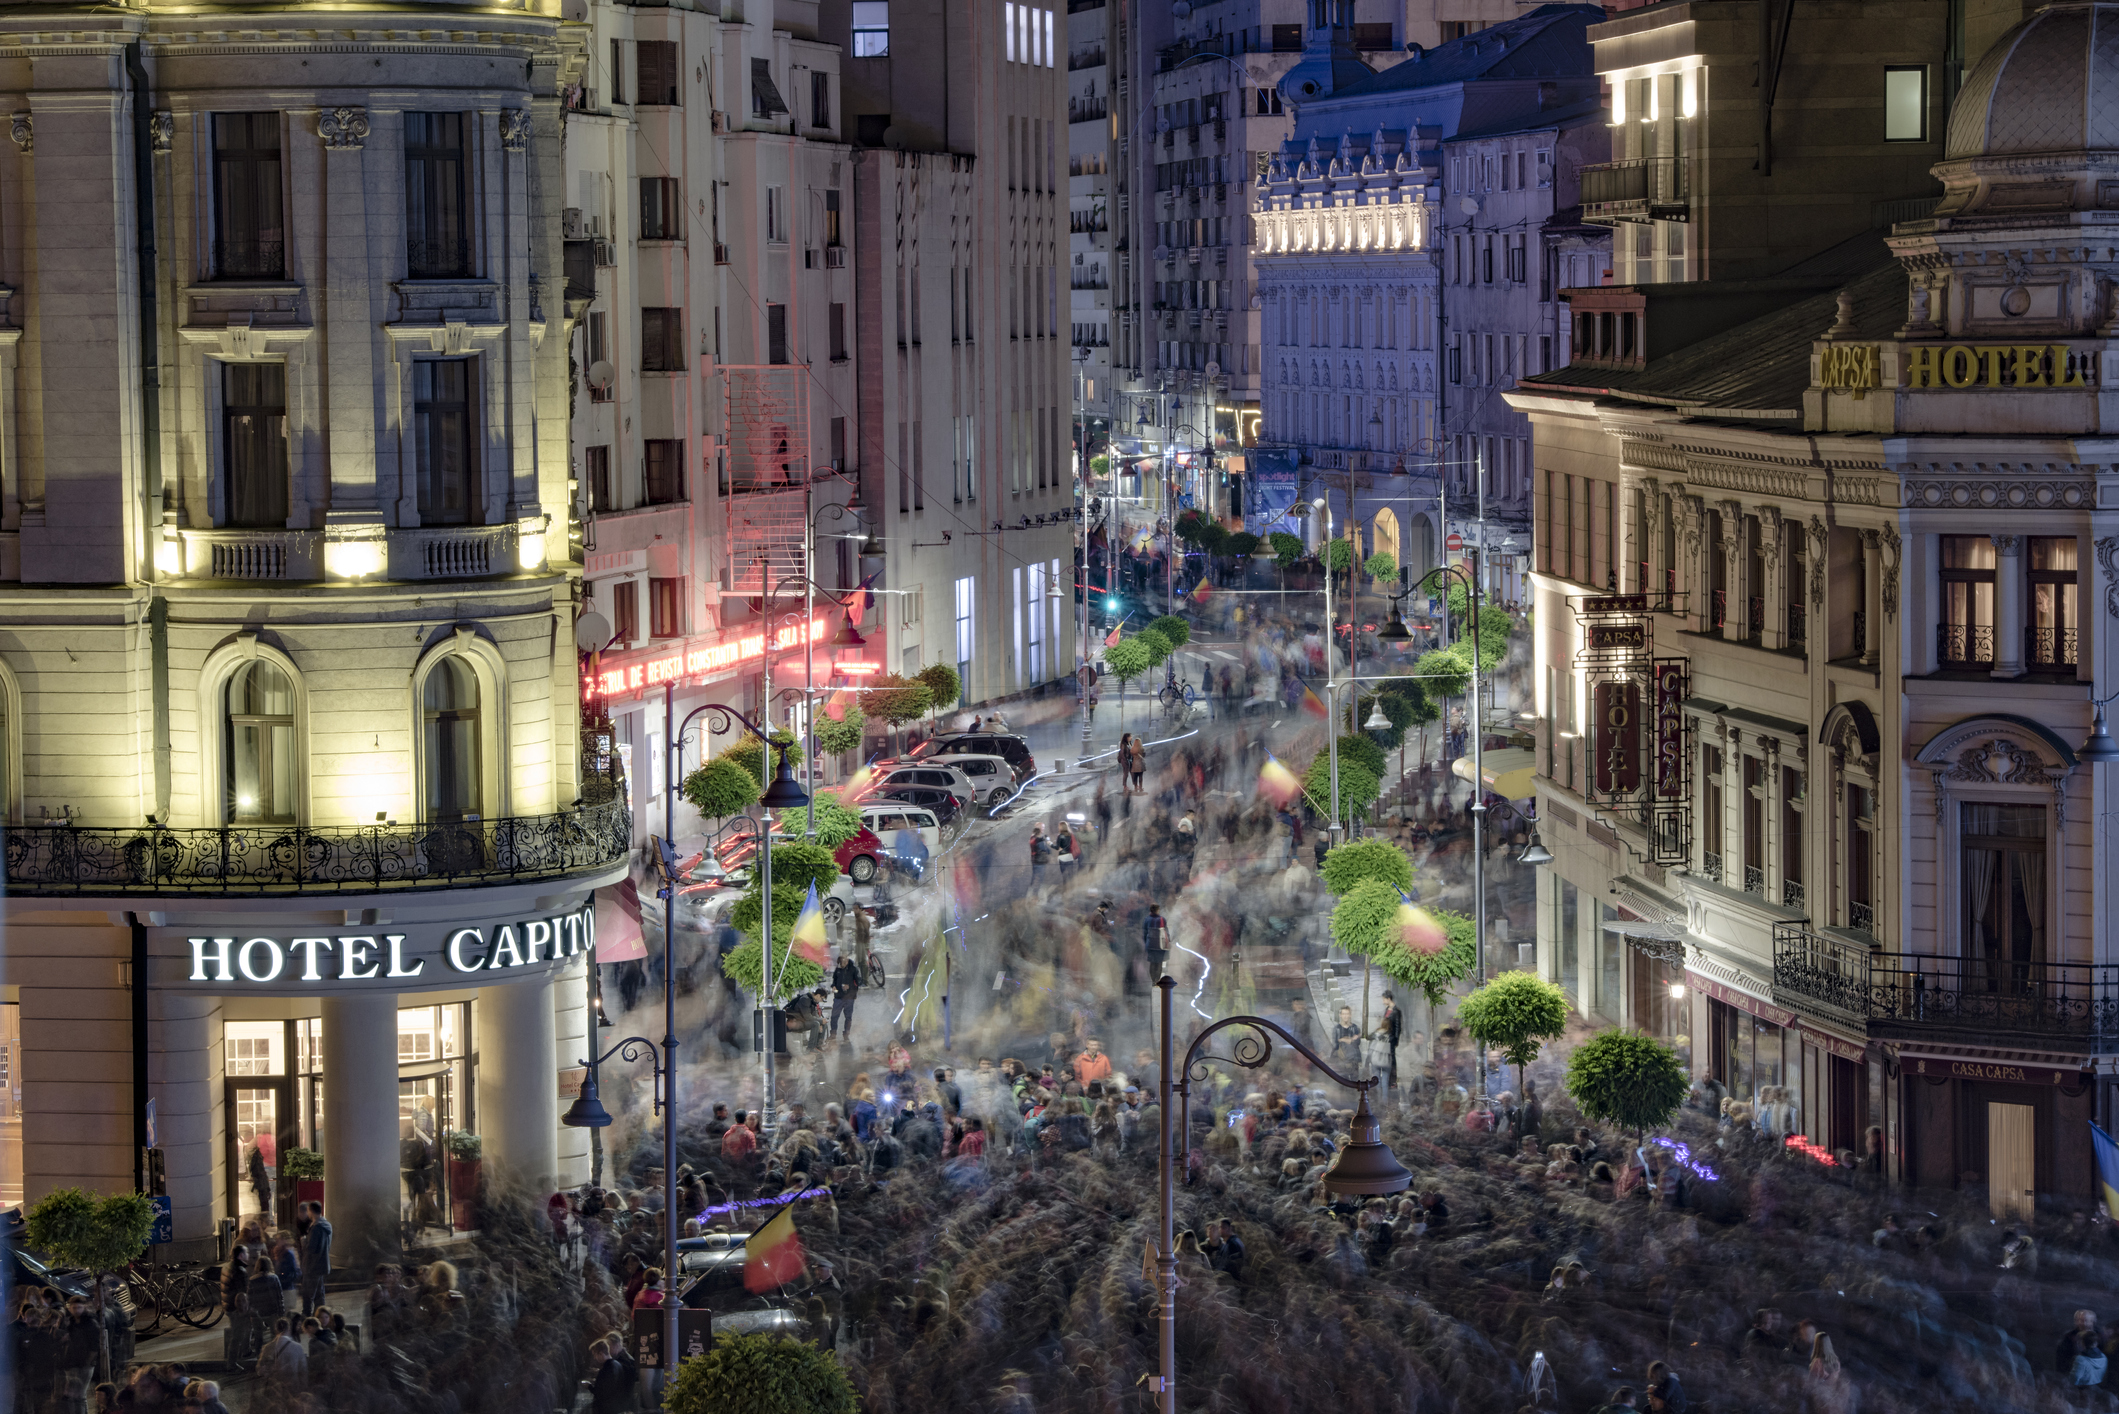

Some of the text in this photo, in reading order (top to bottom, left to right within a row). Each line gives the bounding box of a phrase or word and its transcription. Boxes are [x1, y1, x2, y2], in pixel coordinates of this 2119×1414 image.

[1909, 345, 2087, 388] HOTEL
[630, 664, 644, 689] DE
[687, 641, 739, 674] CONSTANTIN
[778, 625, 798, 649] SALA
[1607, 685, 1628, 793] HOTEL
[188, 906, 596, 982] HOTEL CAPITO
[1951, 1062, 2026, 1081] CASA CAPSA
